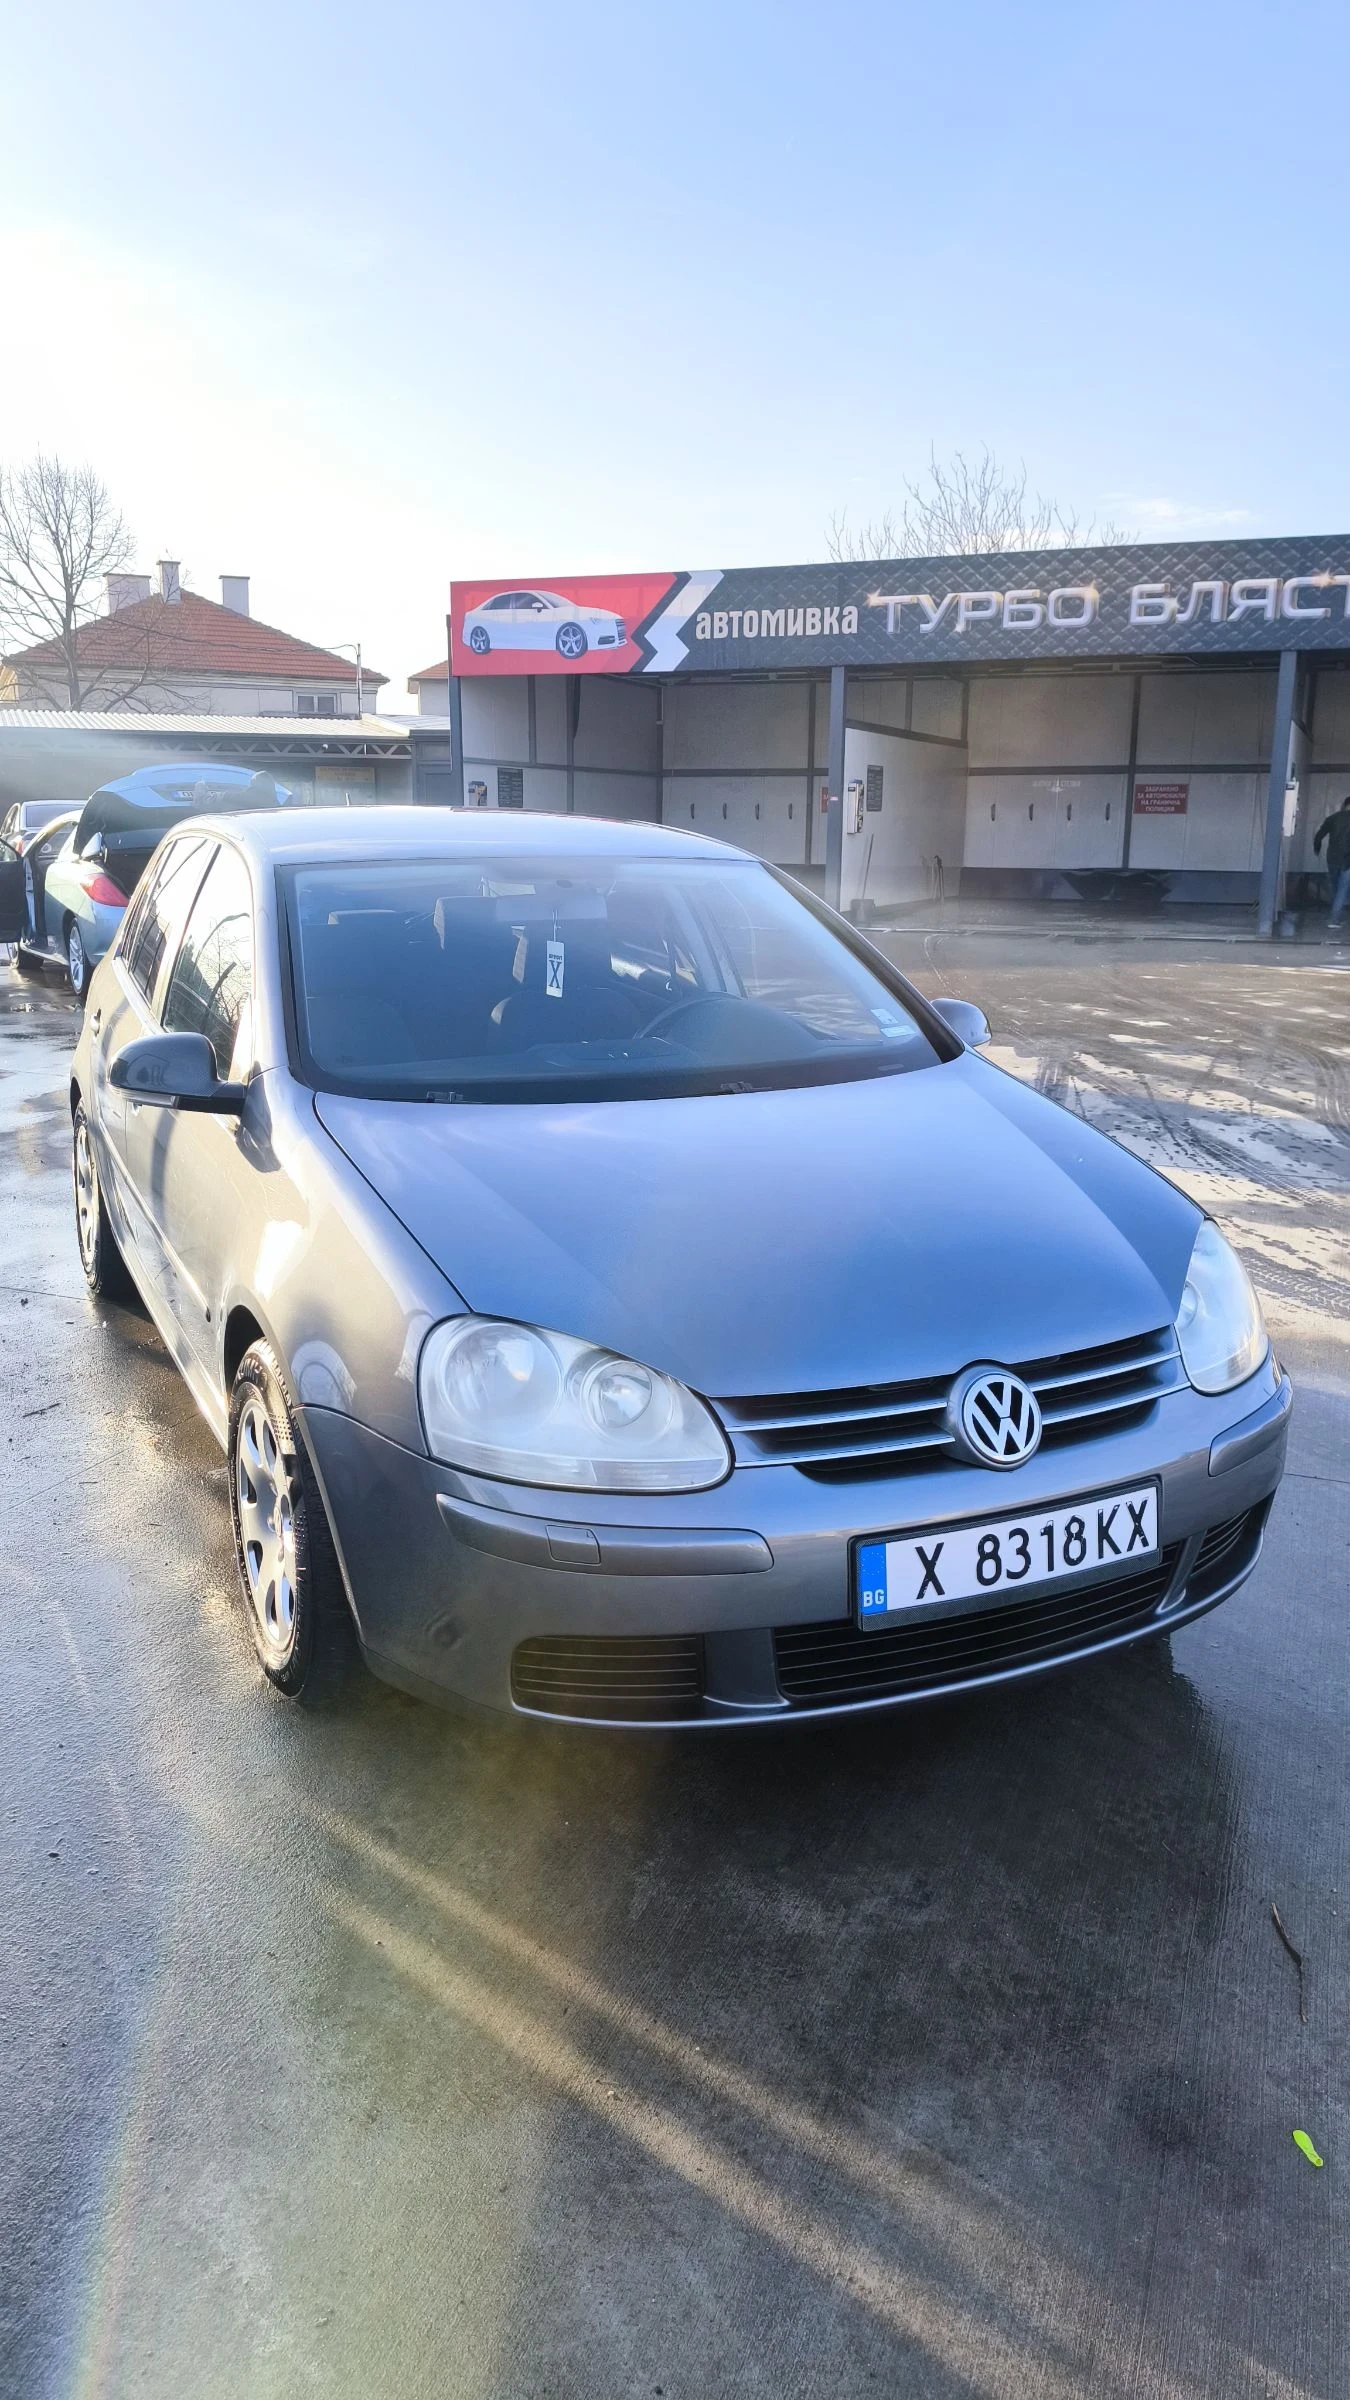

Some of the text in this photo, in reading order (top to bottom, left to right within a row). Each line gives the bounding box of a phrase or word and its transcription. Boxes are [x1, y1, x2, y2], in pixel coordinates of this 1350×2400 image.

[695, 605, 858, 640] автомивка
[869, 587, 1099, 634] ТУРБО
[1145, 785, 1179, 793] ЗАБРАНЕНО
[548, 959, 562, 989] X
[914, 1542, 946, 1600] X
[862, 1589, 885, 1608] BG
